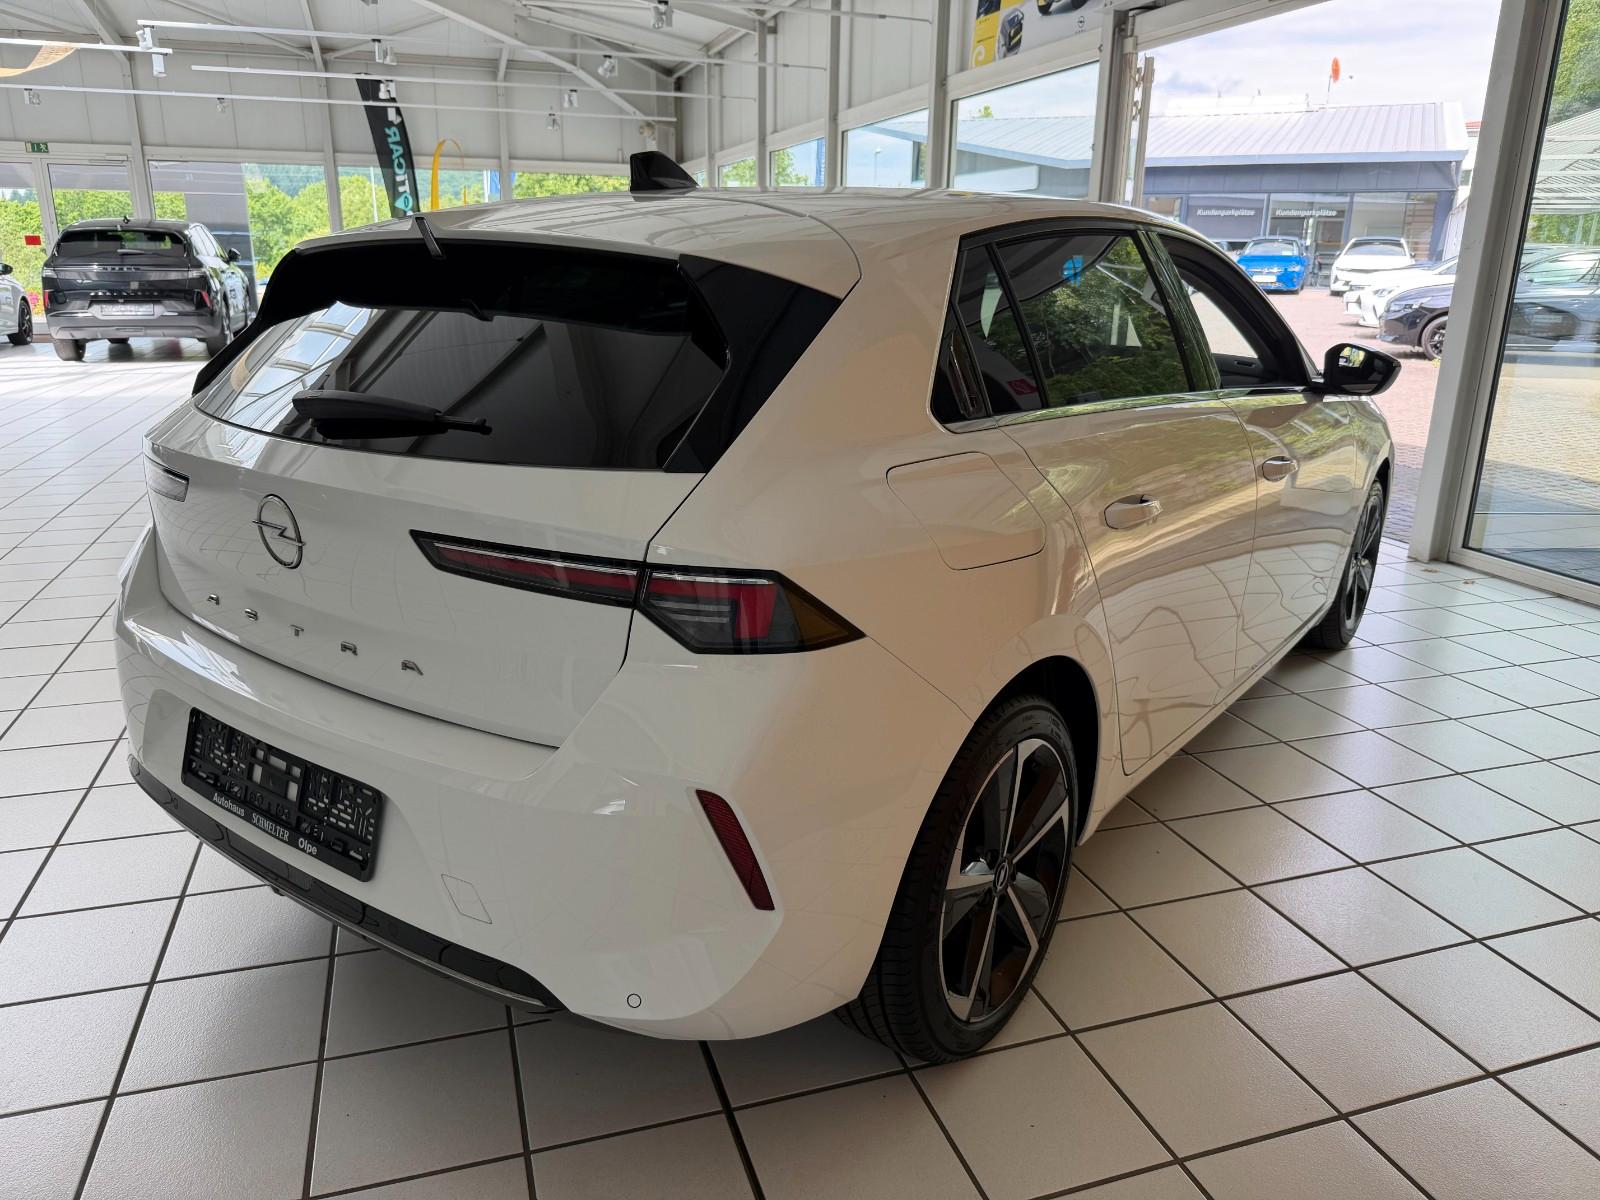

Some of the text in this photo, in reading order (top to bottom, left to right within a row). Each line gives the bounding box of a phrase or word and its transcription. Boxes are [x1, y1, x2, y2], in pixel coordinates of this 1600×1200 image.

[207, 593, 423, 676] ASTRA
[213, 793, 318, 856] Autohaus SCHMELTER Olpe
